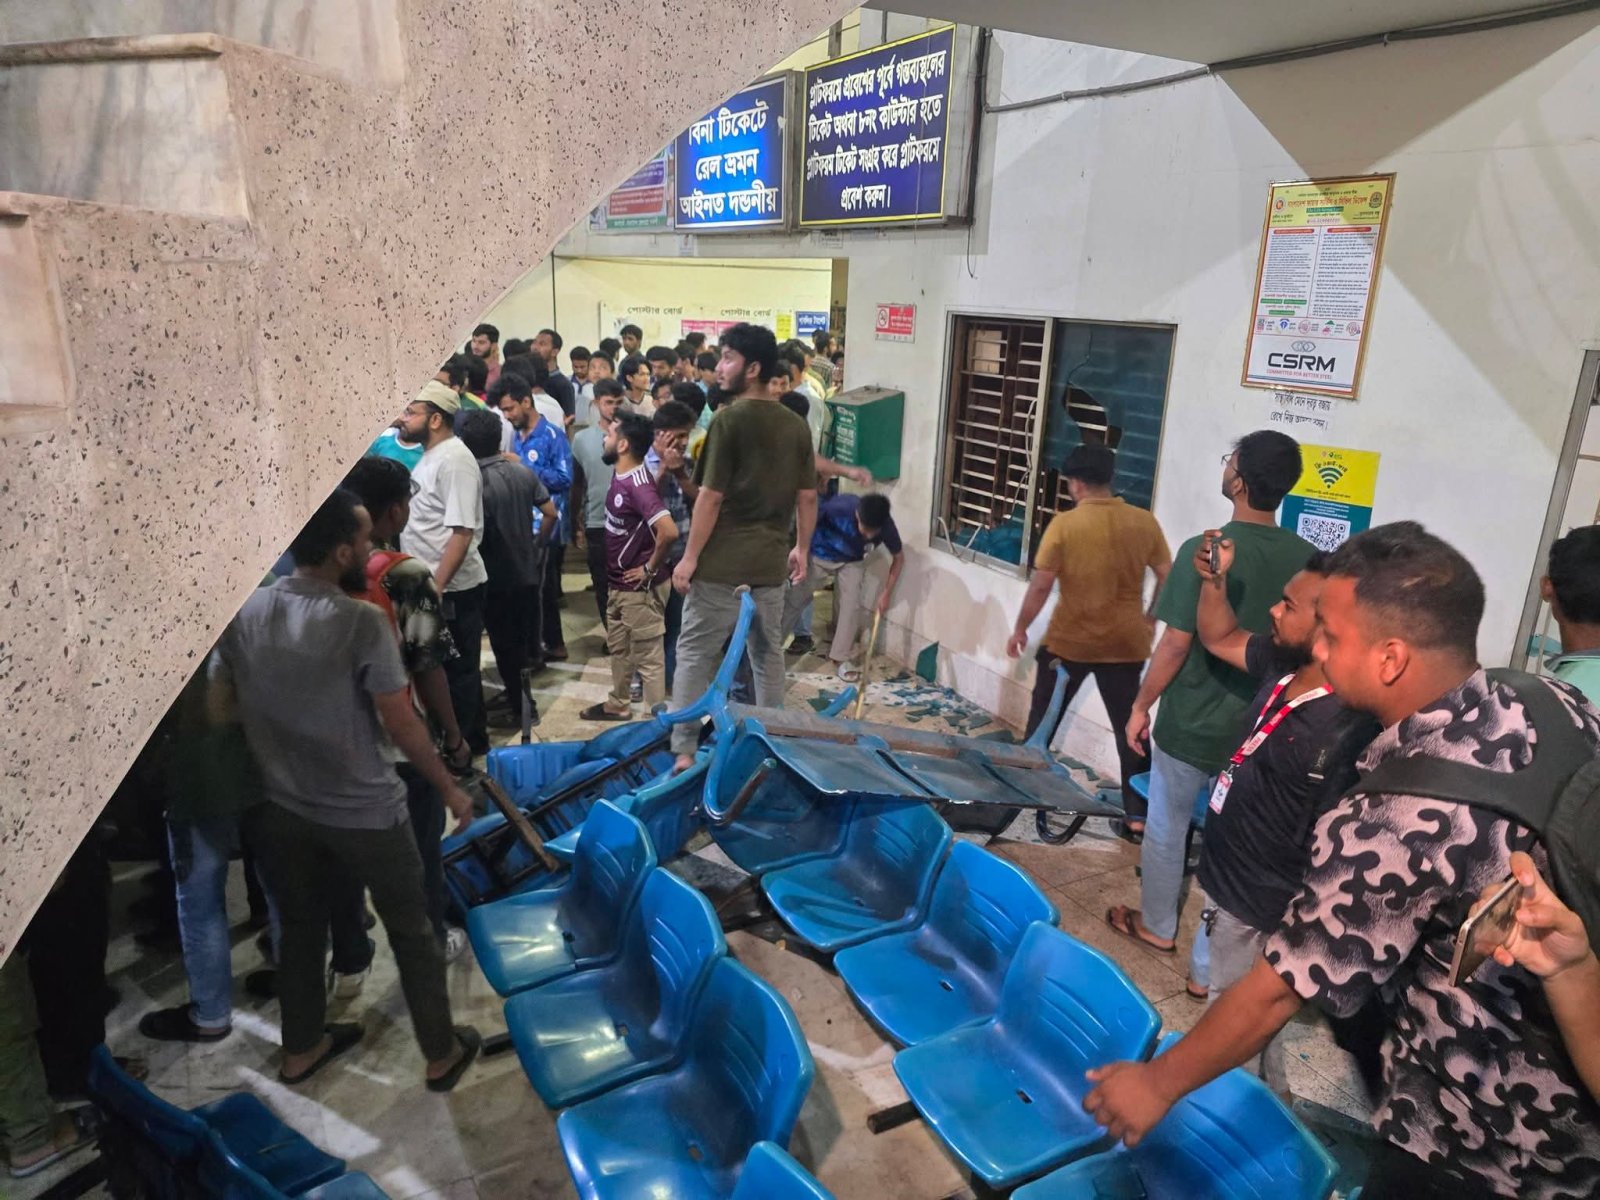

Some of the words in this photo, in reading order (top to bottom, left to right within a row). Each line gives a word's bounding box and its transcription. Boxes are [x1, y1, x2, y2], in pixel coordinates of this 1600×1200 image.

[843, 68, 875, 100] প্রবেশের
[876, 54, 897, 99] পূর্বে
[896, 50, 946, 87] গন্তব্যস্থলের
[717, 98, 769, 141] টিকেটে
[808, 110, 833, 143] টিকেট
[833, 108, 858, 138] অথবা
[878, 96, 918, 130] কাউন্টার
[919, 93, 943, 126] হতে
[695, 155, 723, 182] রেল
[835, 143, 858, 176] টিকেট
[858, 145, 880, 173] সংগ্রহ
[881, 143, 899, 169] করে
[679, 188, 726, 221] আইনত
[840, 184, 863, 213] প্রবেশ
[627, 306, 660, 315] পোস্টার
[663, 306, 683, 315] বোর্ড
[720, 308, 750, 317] পোস্টার
[753, 308, 772, 317] বোর্ড
[1266, 369, 1292, 377] COMMITTED
[1302, 371, 1319, 379] BETTER
[1320, 372, 1332, 380] STEEL
[1268, 352, 1336, 373] CSRM
